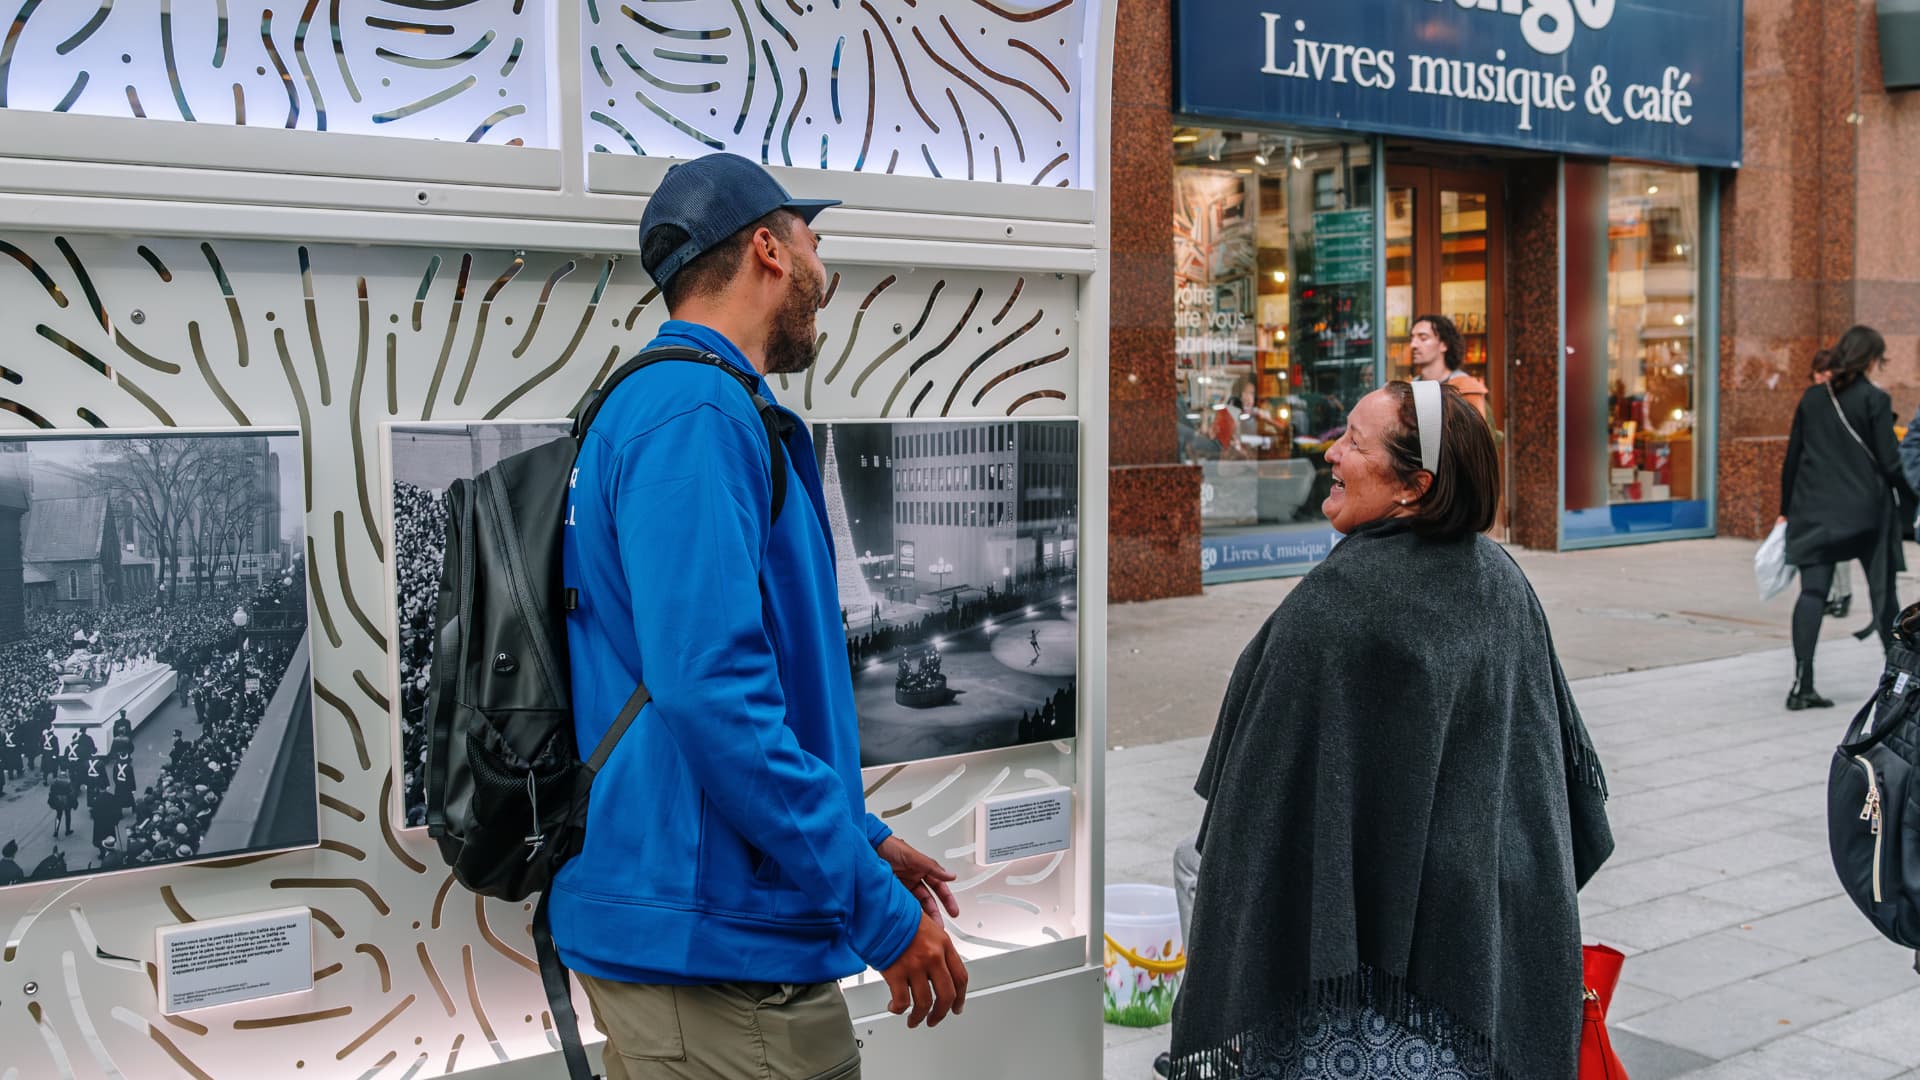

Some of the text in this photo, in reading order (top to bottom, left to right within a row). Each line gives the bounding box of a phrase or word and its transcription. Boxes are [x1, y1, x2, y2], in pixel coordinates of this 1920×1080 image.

[1260, 12, 1395, 89] Livres
[1408, 49, 1575, 131] musique
[1584, 64, 1622, 125] &
[1623, 66, 1692, 125] café
[1206, 312, 1245, 329] vous
[1223, 545, 1259, 562] Livres
[1262, 544, 1272, 560] &
[1277, 540, 1326, 560] musique
